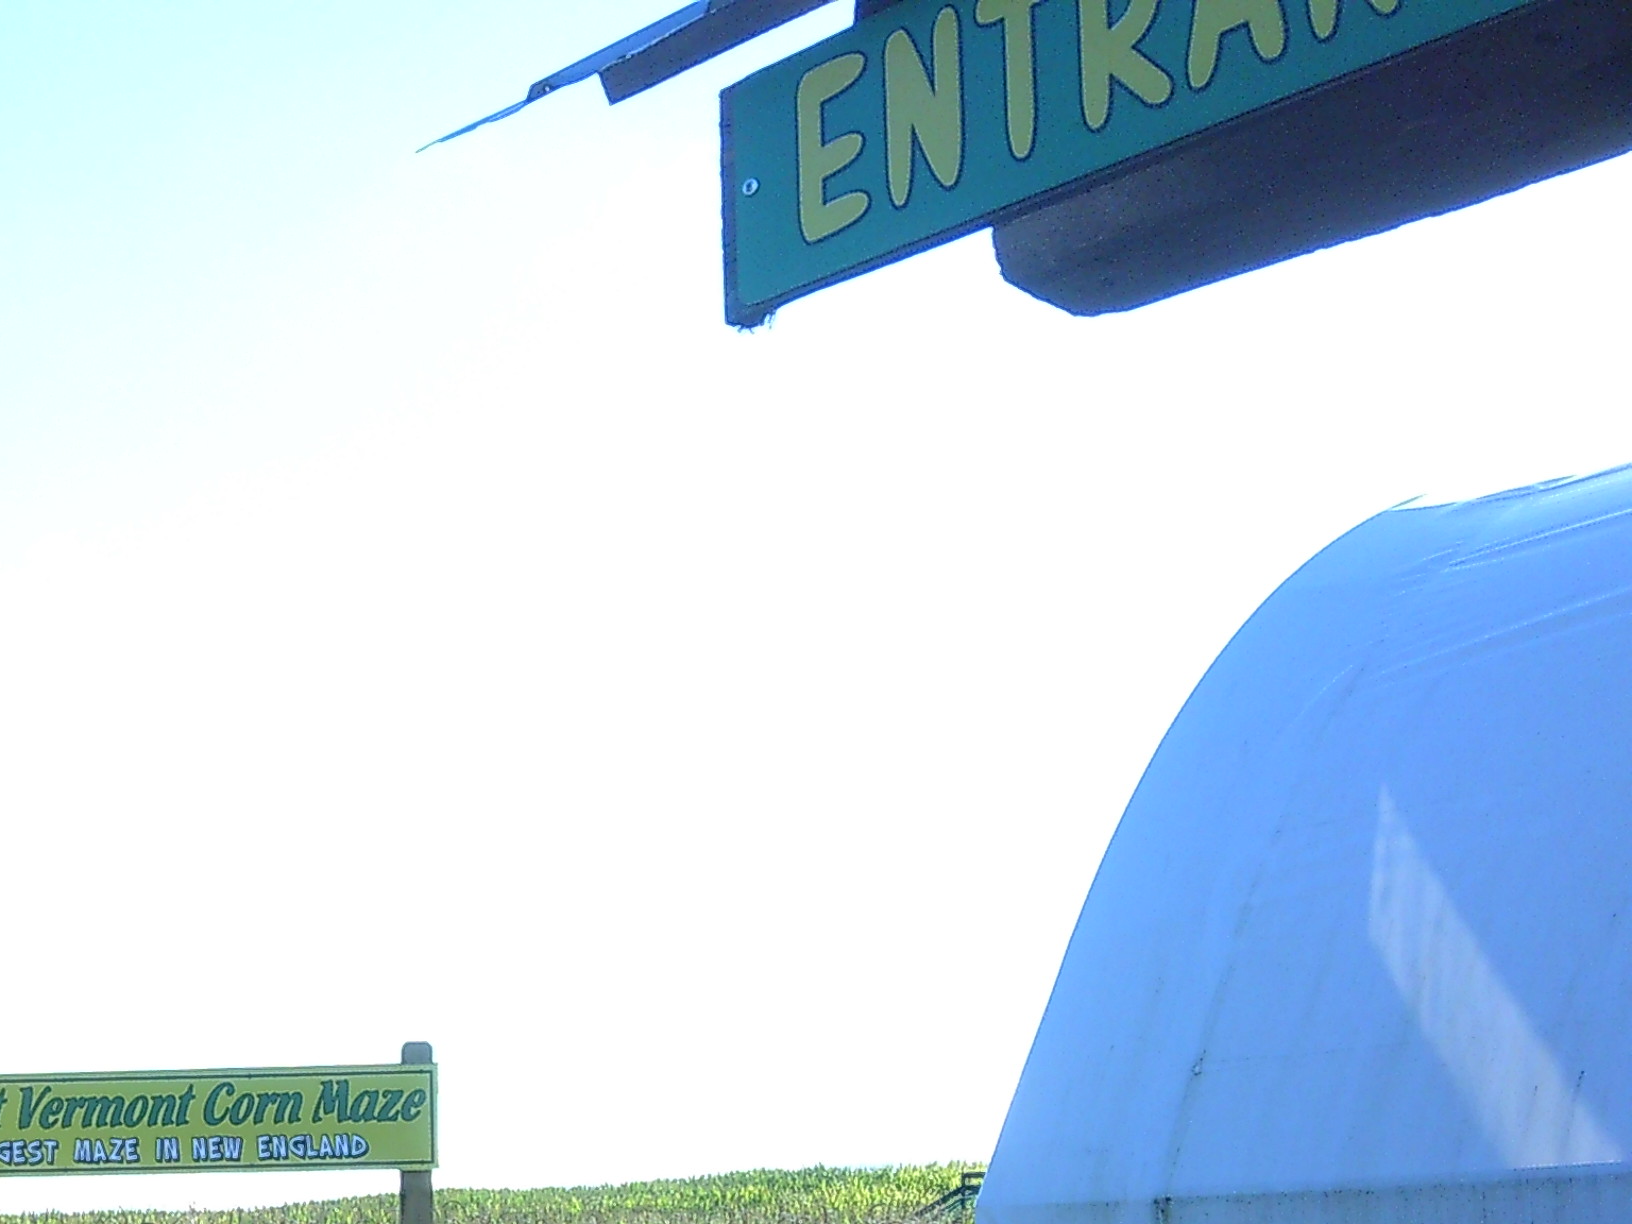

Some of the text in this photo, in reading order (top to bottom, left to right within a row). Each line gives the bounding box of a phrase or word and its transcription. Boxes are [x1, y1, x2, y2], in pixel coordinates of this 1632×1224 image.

[794, 0, 1402, 246] ENTRA
[17, 1083, 196, 1131] Vermont
[203, 1081, 304, 1126] Corn
[312, 1079, 428, 1124] Maze
[73, 1137, 140, 1164] MAZE
[155, 1137, 180, 1162] IN
[192, 1135, 244, 1162] NEW
[256, 1133, 370, 1160] ENGLAND
